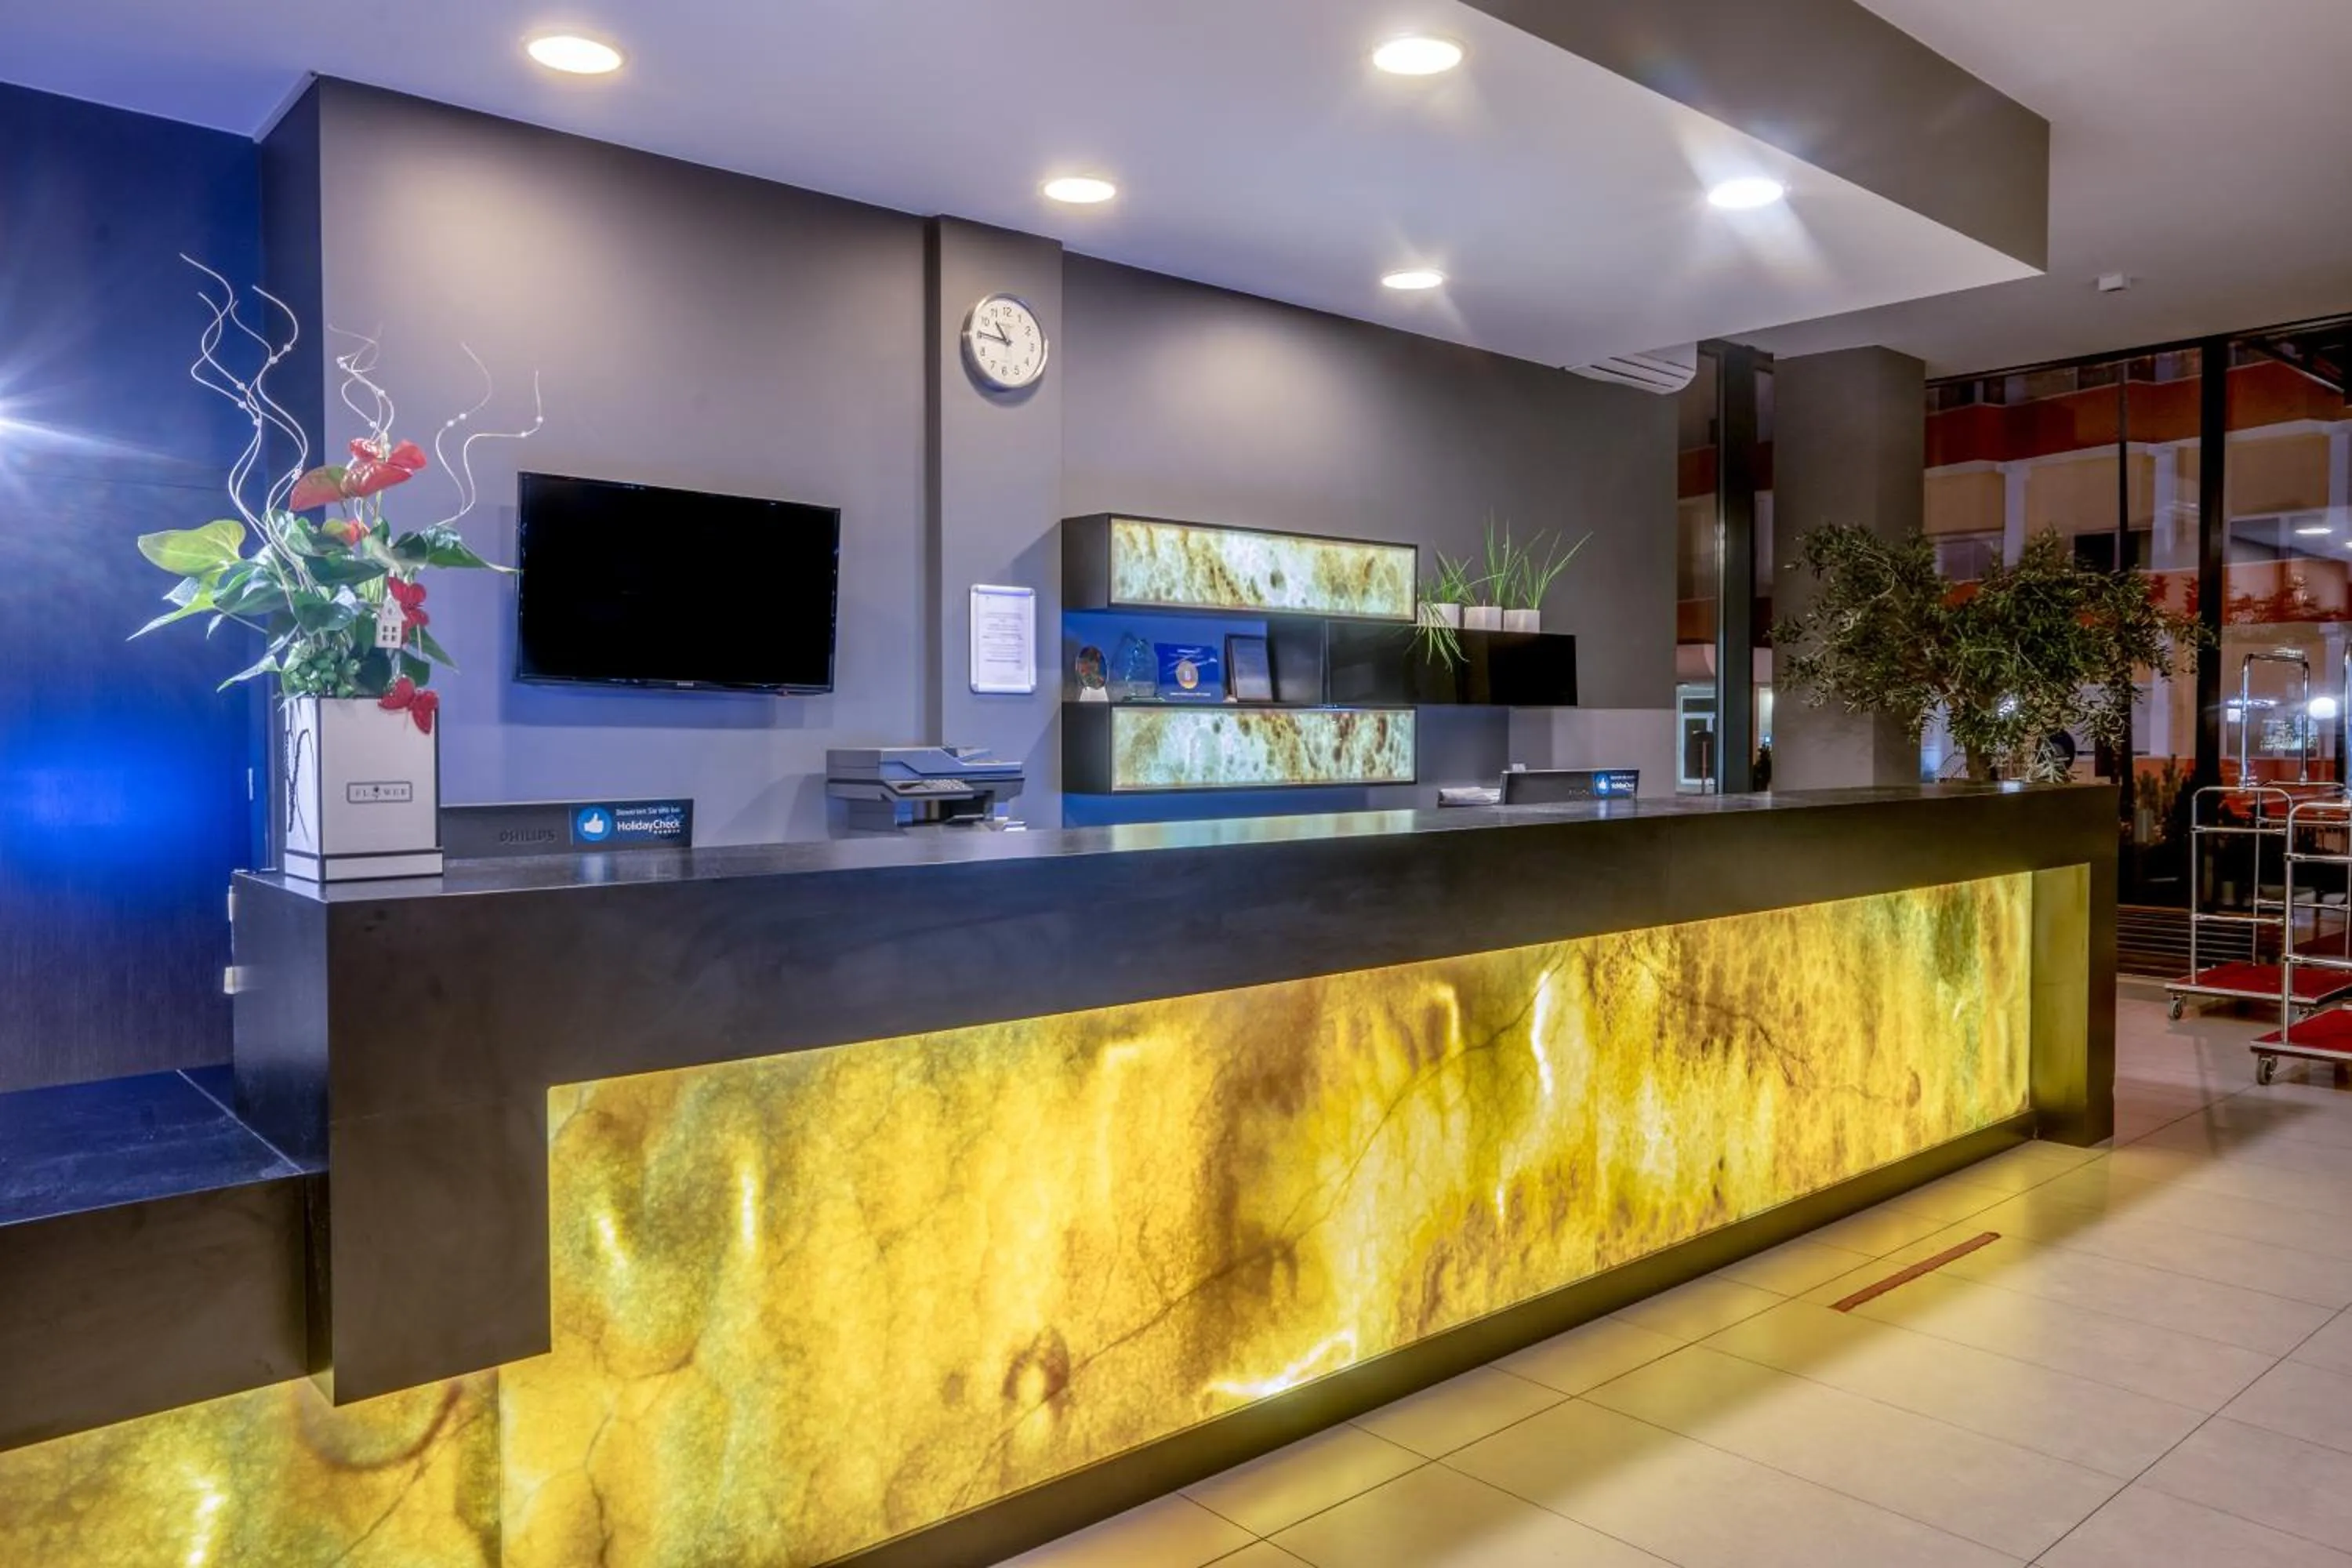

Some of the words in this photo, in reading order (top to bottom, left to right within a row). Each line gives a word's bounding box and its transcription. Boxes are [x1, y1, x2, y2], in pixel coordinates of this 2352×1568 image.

[1004, 307, 1012, 317] 12
[982, 316, 989, 326] 10
[1025, 325, 1031, 336] 2
[990, 360, 996, 369] 7
[1001, 366, 1007, 376] 6
[1014, 365, 1019, 375] 5
[617, 819, 680, 833] HolidayCheck
[499, 829, 556, 842] PHILIPS
